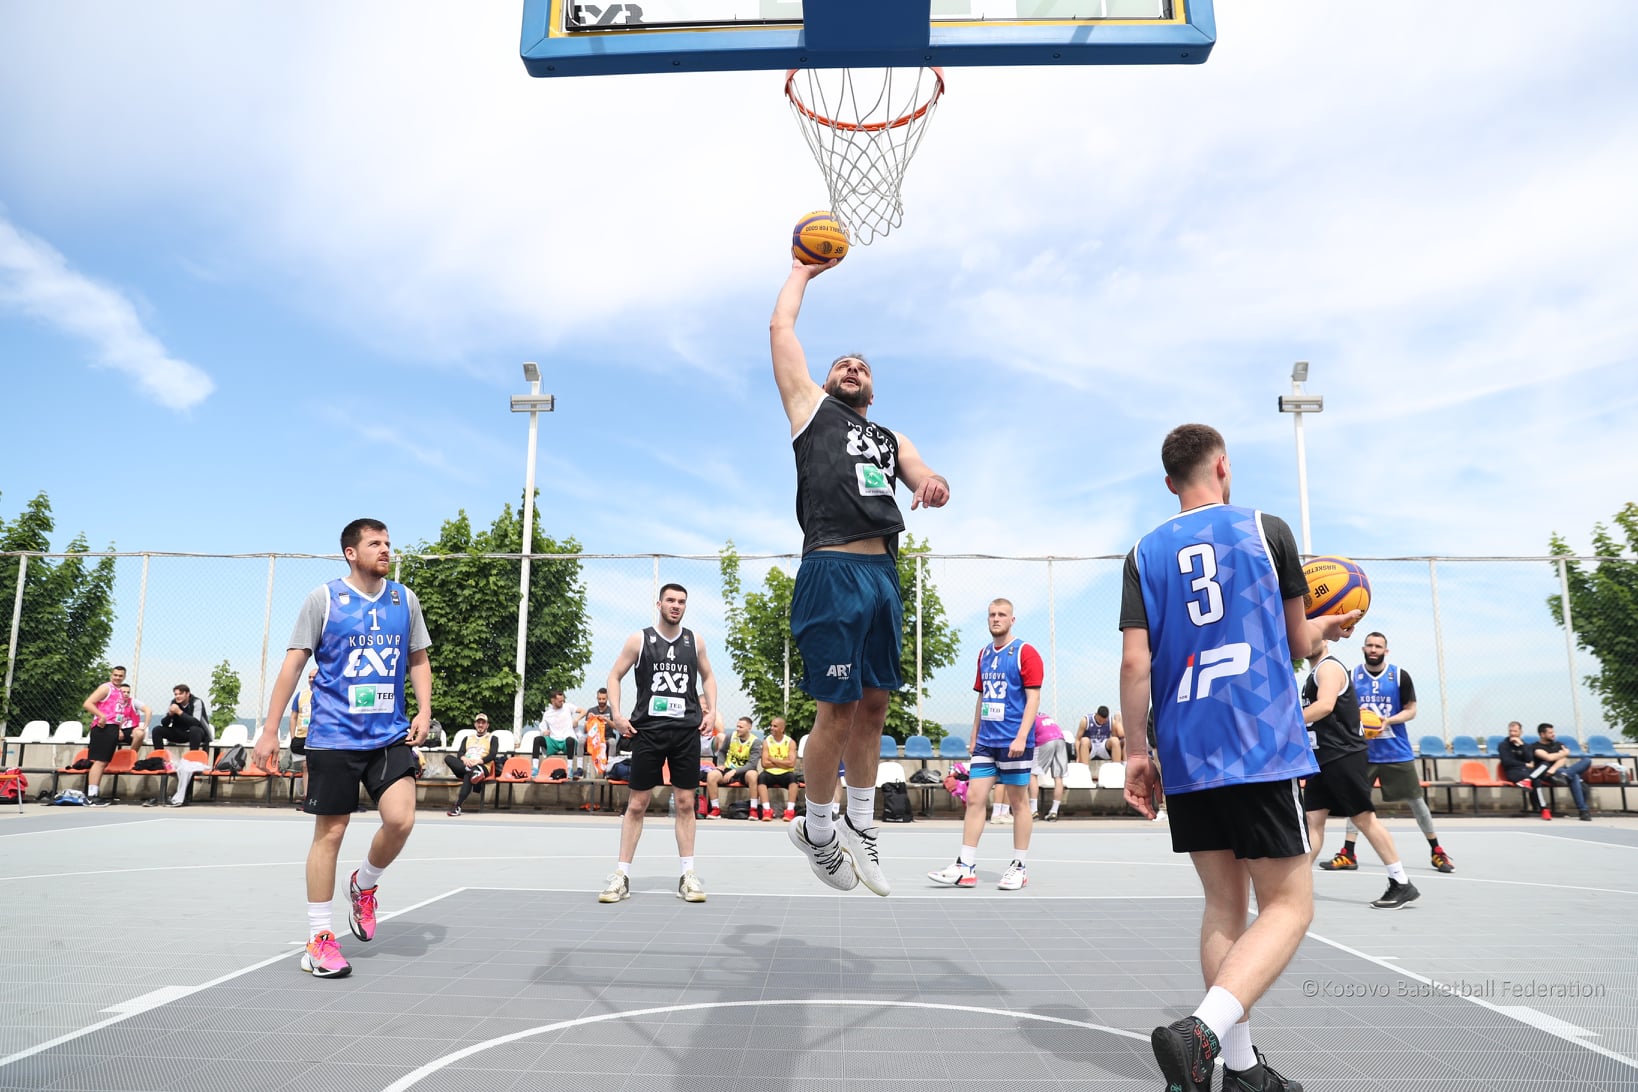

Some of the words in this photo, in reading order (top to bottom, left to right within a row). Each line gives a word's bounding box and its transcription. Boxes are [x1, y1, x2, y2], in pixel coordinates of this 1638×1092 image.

[1177, 543, 1224, 627] 3
[1314, 583, 1330, 598] IBF
[368, 608, 381, 631] 1
[349, 634, 400, 647] KOSOVA
[666, 645, 676, 661] 4
[653, 662, 688, 673] KOSOVA
[990, 655, 999, 671] 4
[1371, 680, 1380, 694] 2
